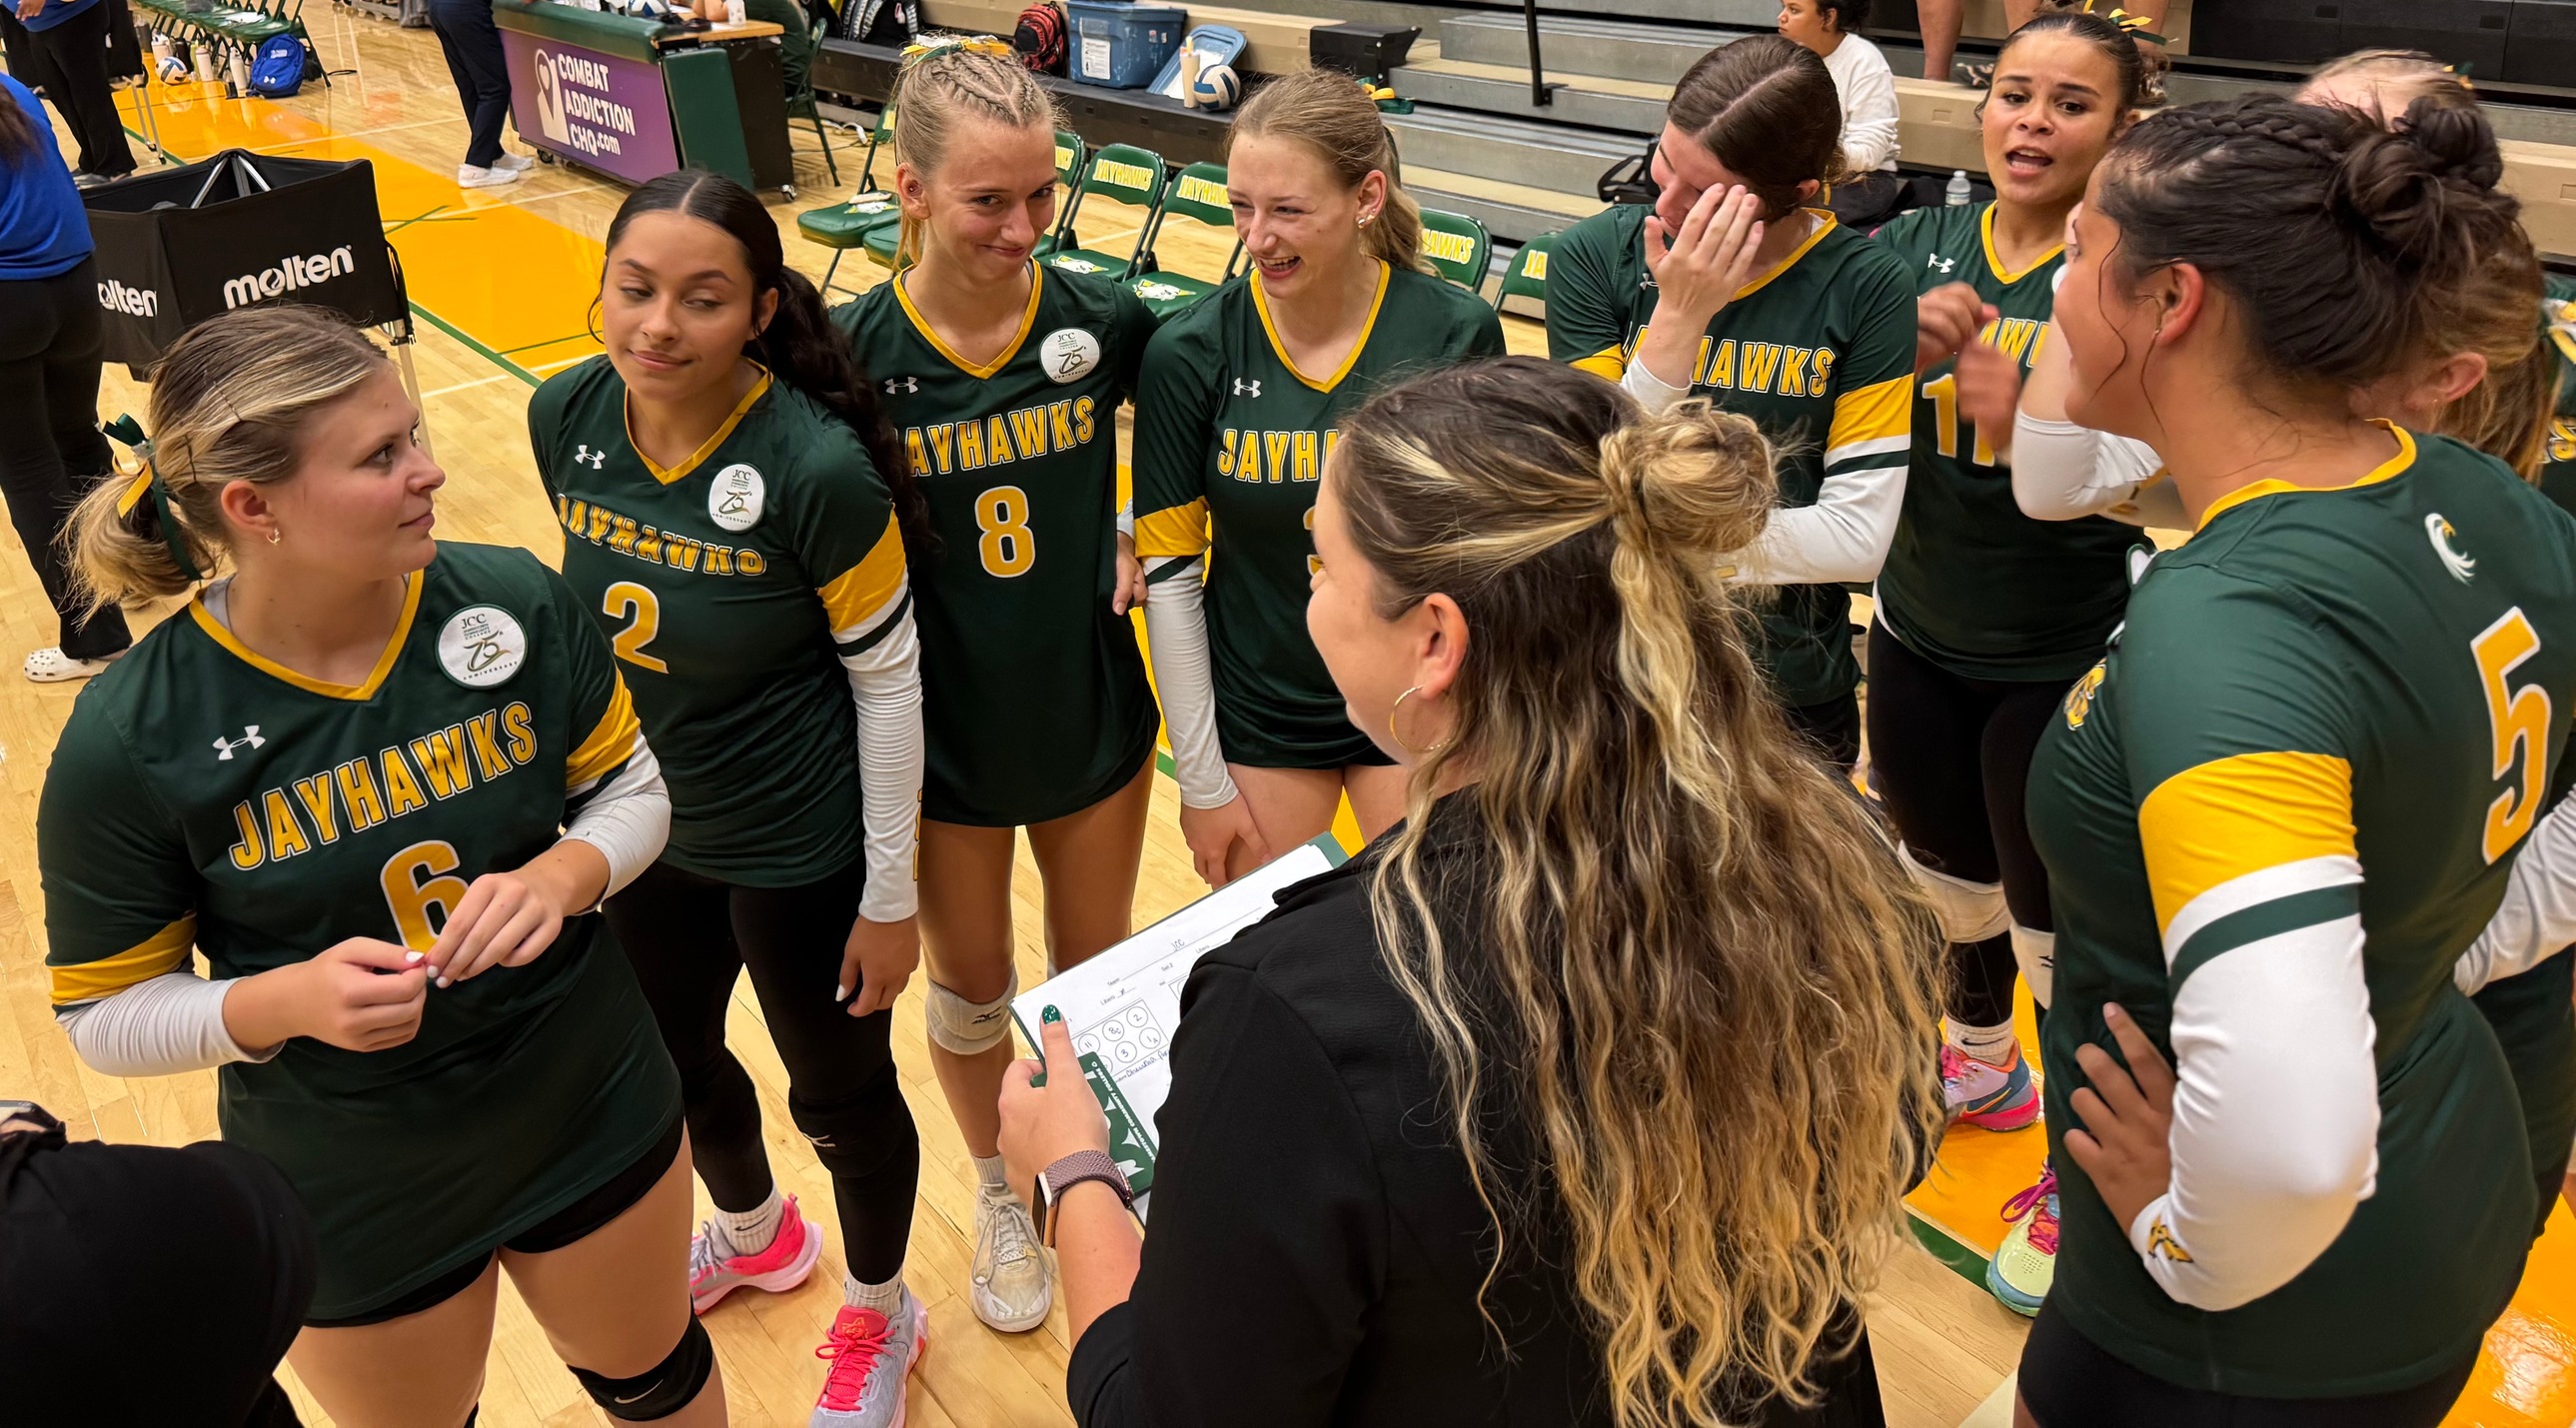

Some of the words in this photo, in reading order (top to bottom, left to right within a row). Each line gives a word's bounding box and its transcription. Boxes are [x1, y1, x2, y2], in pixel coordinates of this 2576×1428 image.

[558, 53, 610, 92] COMBAT
[565, 88, 637, 137] ADDICTION
[570, 123, 622, 157] CHQ.com
[1092, 158, 1154, 192] JAYHAWKS
[1176, 175, 1233, 210] JAYHAW
[223, 246, 355, 310] molten
[1057, 332, 1076, 343] JCC
[894, 396, 1095, 479] AYHAWKS
[731, 469, 751, 482] JCC
[974, 485, 1036, 578] 8
[462, 614, 487, 629] JCC
[603, 581, 669, 675] 2
[2470, 606, 2552, 865] 5
[228, 701, 538, 871] JAYHAWKS
[380, 839, 470, 954] 6
[1133, 1013, 1143, 1022] 2
[1120, 1048, 1129, 1058] 3
